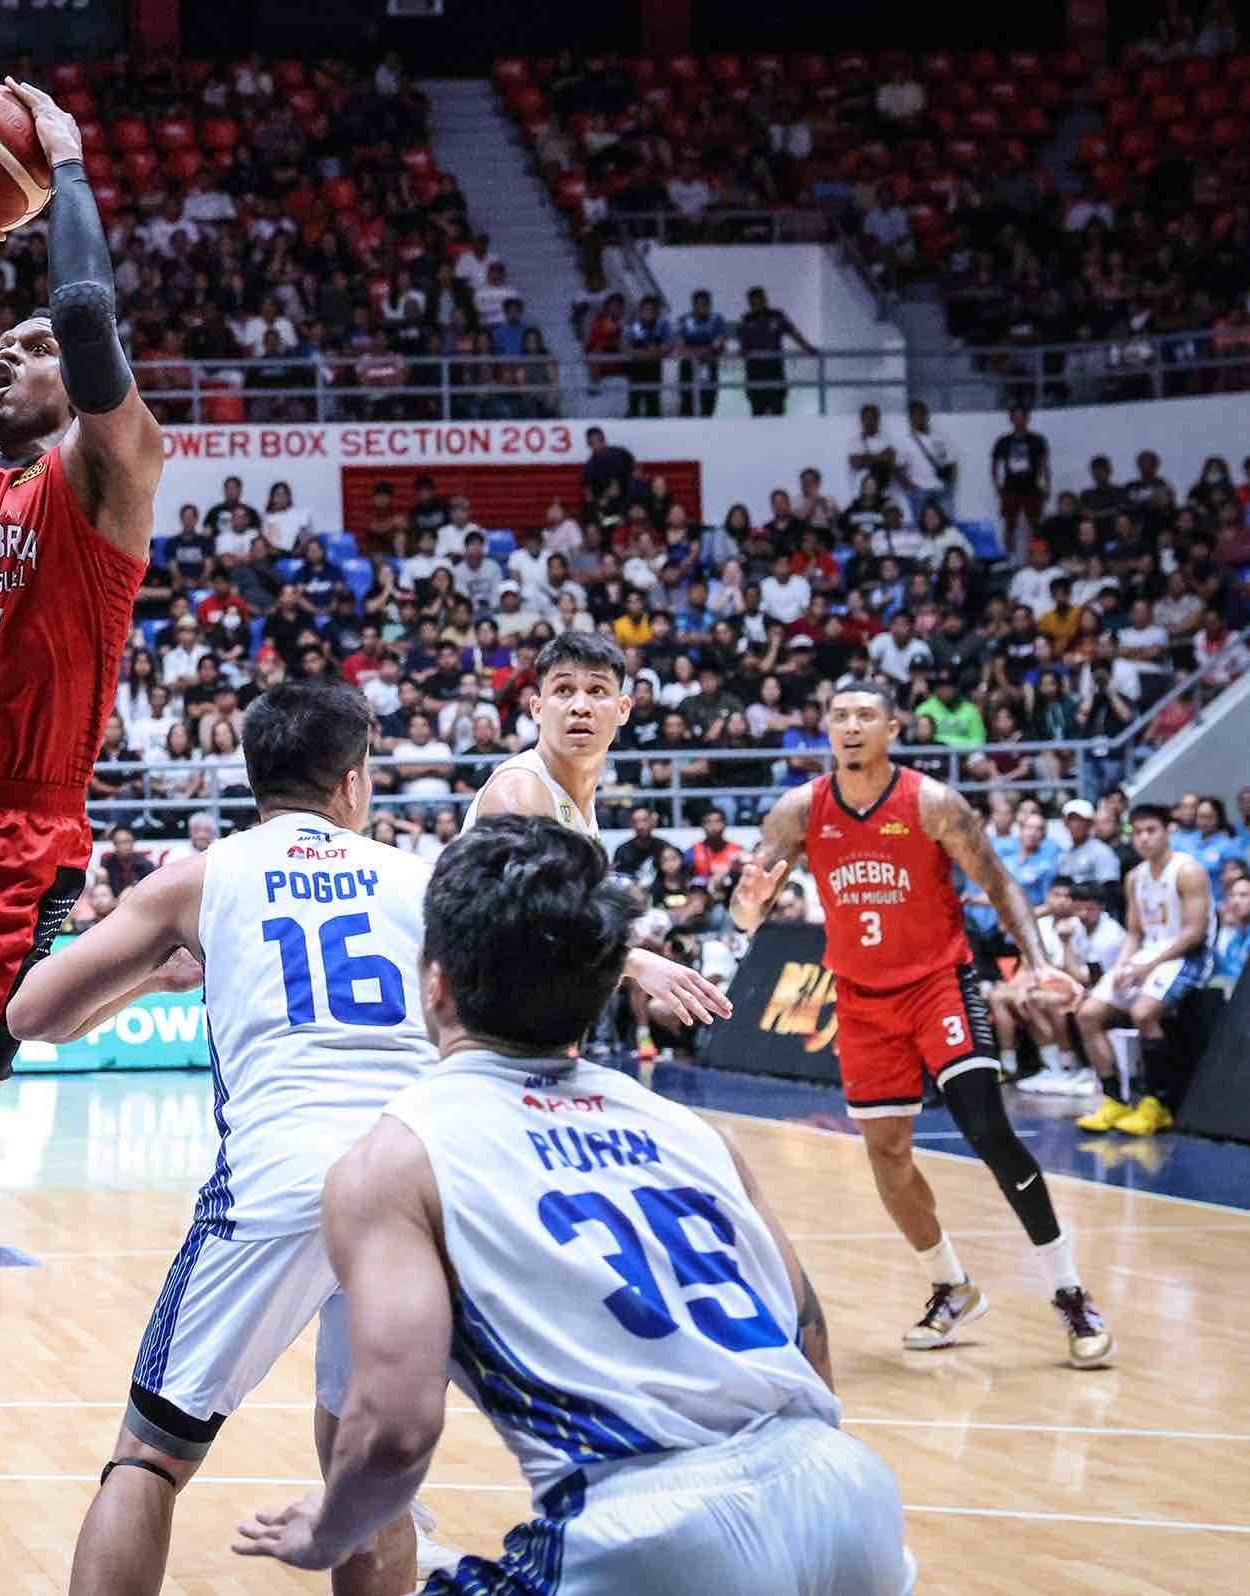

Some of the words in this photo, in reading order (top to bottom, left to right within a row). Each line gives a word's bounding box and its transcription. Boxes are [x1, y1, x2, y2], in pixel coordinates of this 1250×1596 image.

[162, 430, 250, 458] OWER
[259, 431, 327, 457] BOX
[341, 427, 491, 457] SECTION
[501, 426, 573, 454] 203
[264, 869, 379, 904] POGOY
[829, 860, 911, 896] GINEBRA
[860, 910, 883, 948] 3
[262, 912, 407, 1027] 16
[941, 1015, 966, 1047] 3
[537, 1185, 791, 1353] 35
